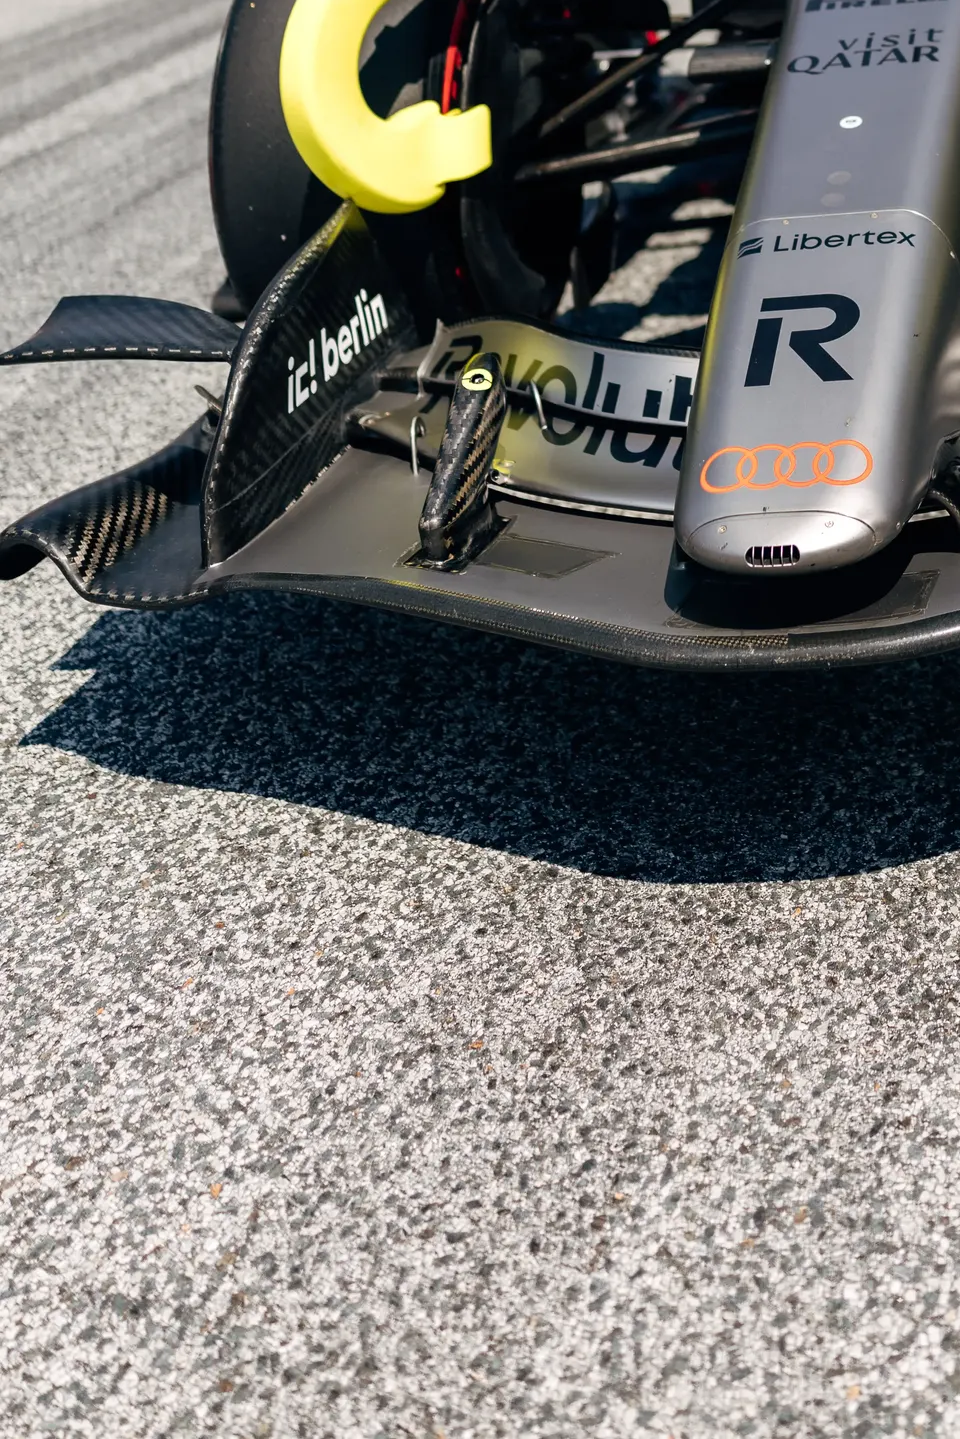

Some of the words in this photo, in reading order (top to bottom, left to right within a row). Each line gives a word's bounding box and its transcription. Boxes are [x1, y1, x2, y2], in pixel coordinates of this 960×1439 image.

[838, 28, 944, 51] visit
[787, 46, 940, 75] QATAR
[773, 230, 916, 253] Libertex
[287, 356, 318, 414] ic!
[320, 288, 388, 382] berlin
[744, 293, 861, 387] R
